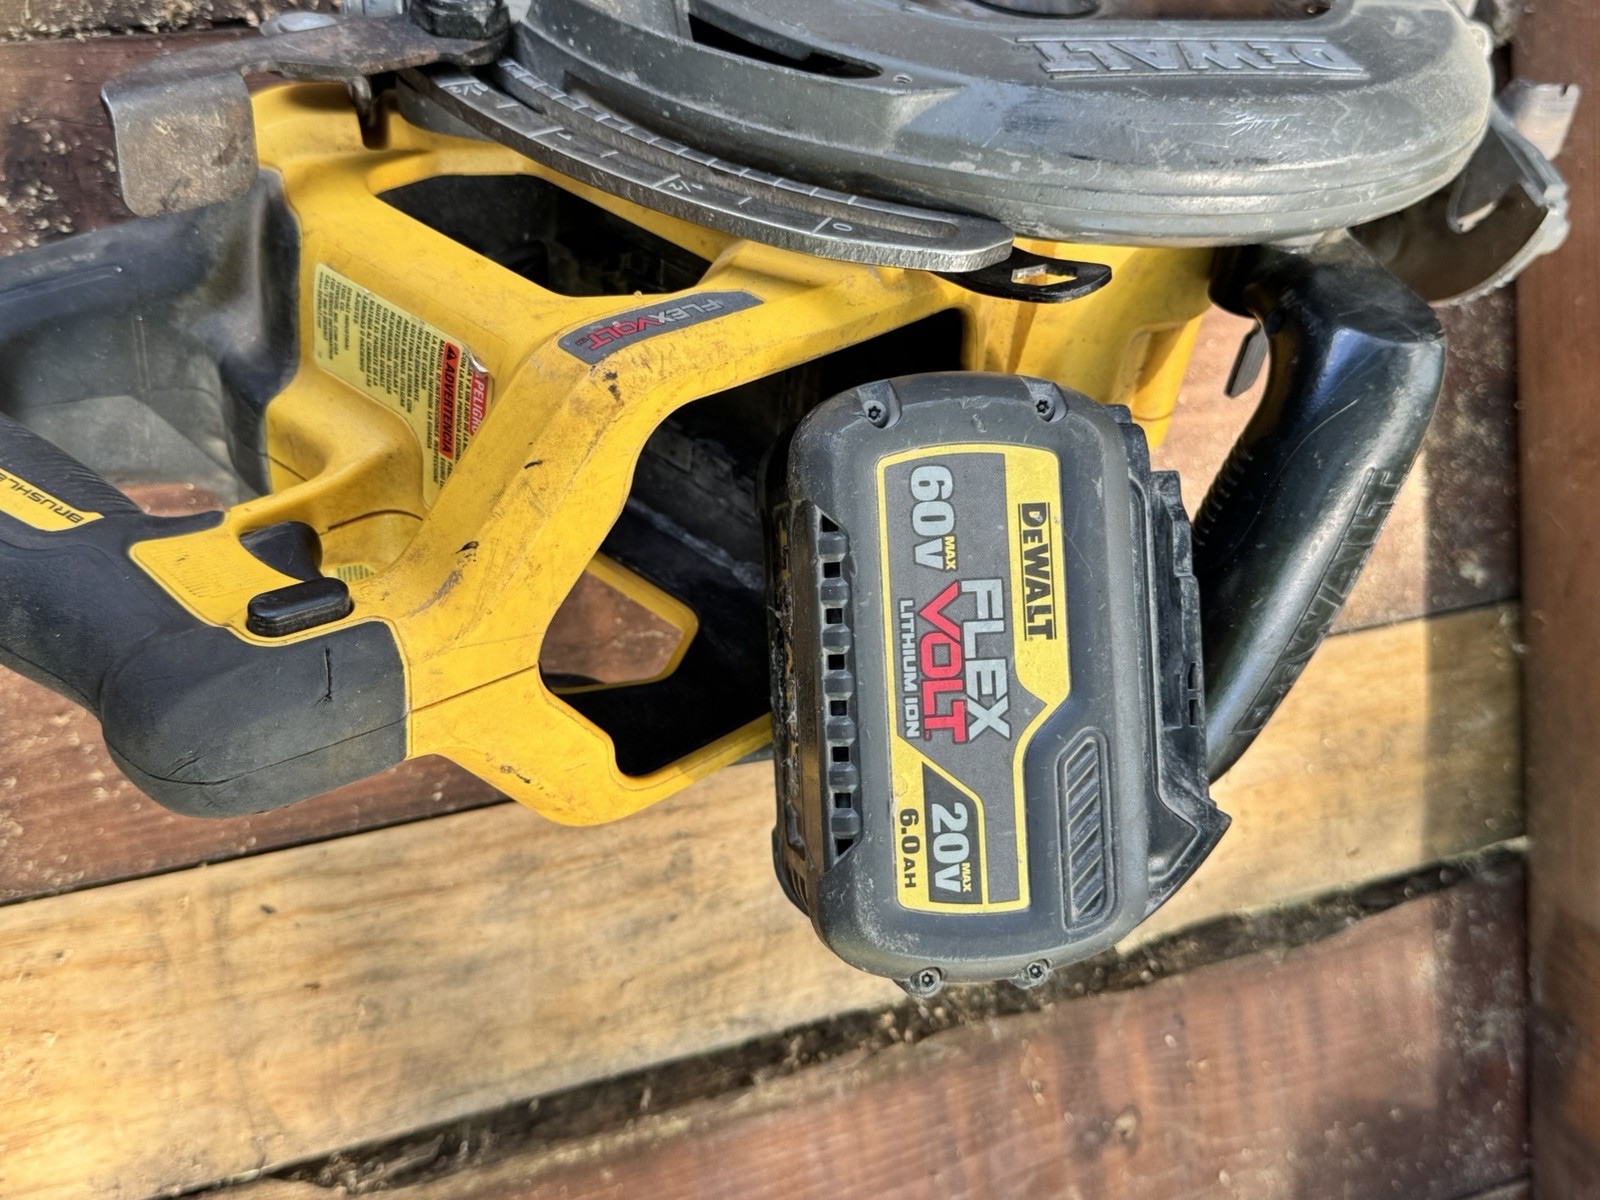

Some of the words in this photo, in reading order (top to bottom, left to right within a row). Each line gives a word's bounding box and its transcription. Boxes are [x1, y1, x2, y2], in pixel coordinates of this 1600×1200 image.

[1031, 40, 1364, 73] DEWALT
[832, 222, 853, 233] 0
[442, 363, 454, 452] ADVERTENCIA
[911, 465, 955, 571] 60V
[944, 535, 957, 571] MAX
[1022, 502, 1054, 641] DEWALT
[900, 599, 918, 692] LITHIUM
[918, 580, 968, 744] VOLT
[960, 578, 1011, 742] FLEX
[905, 697, 920, 739] ION
[930, 801, 971, 893] 20V
[960, 862, 973, 893] MAX
